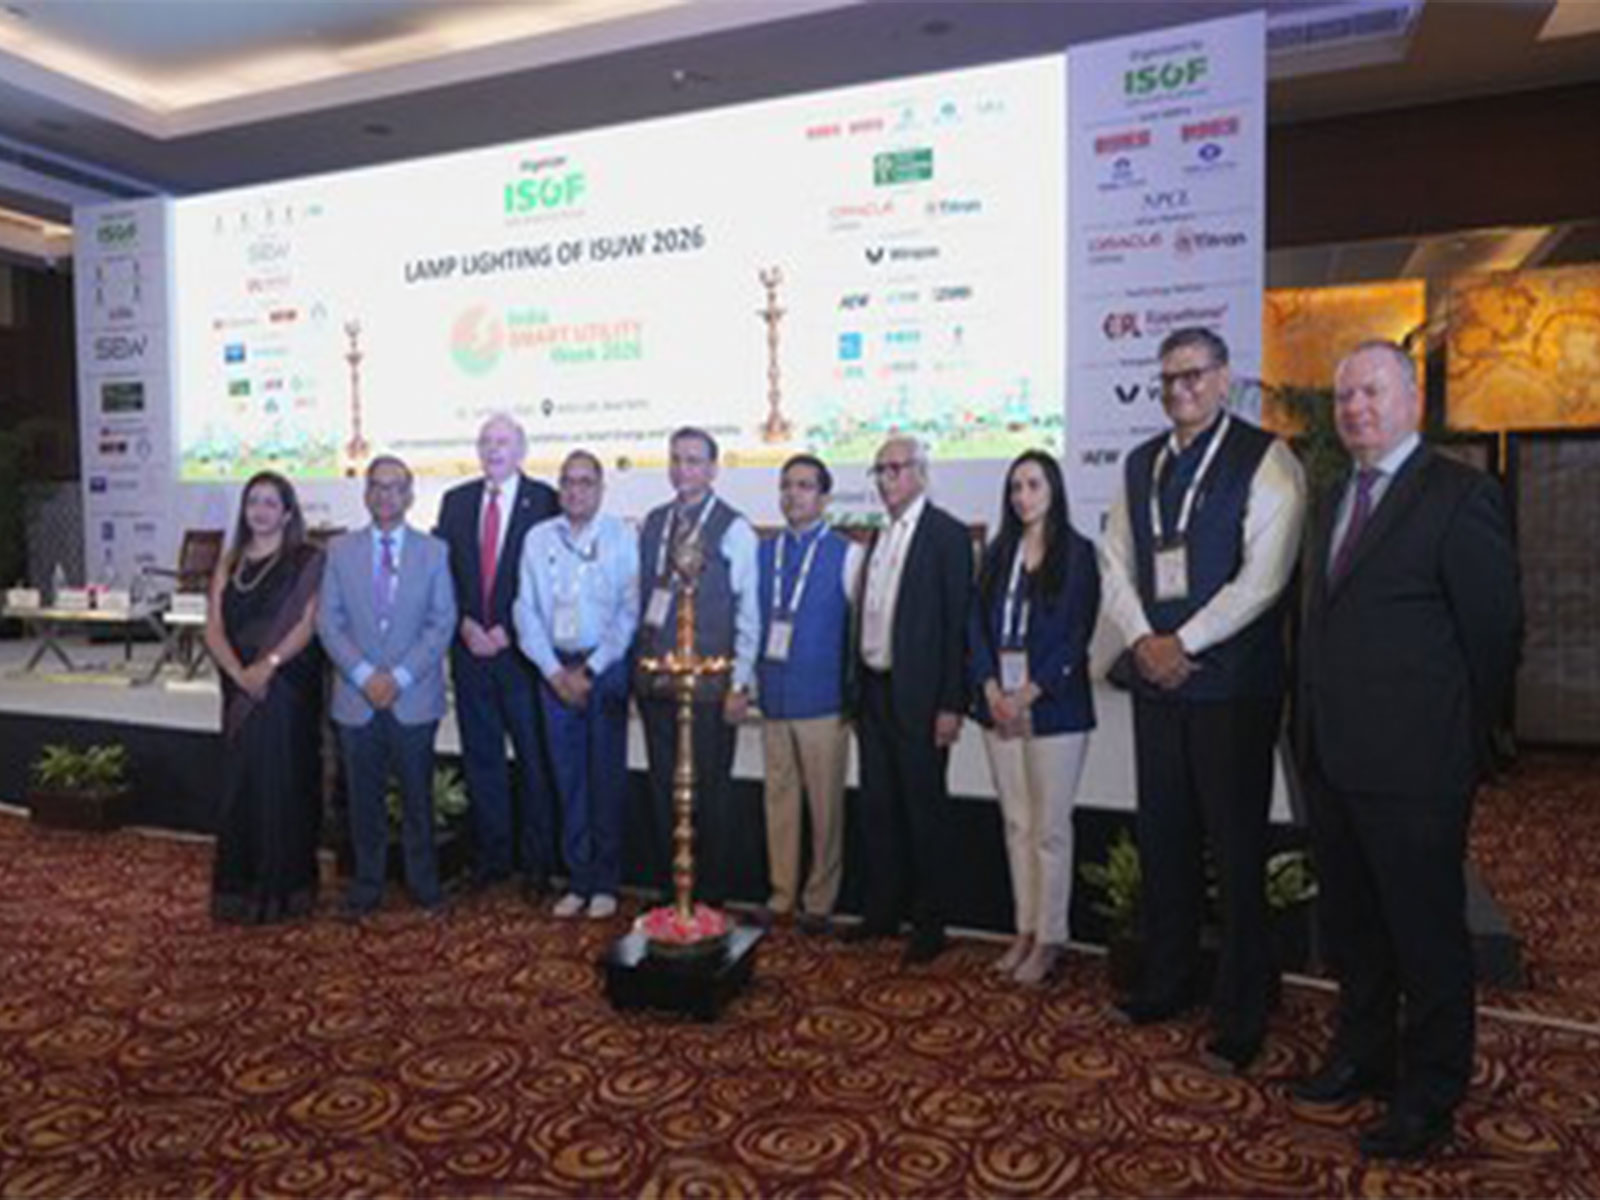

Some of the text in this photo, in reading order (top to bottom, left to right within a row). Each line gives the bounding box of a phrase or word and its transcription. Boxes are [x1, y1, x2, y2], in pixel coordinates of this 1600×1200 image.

[404, 224, 706, 283] LAMP LIGHTING OF ISUW 2026
